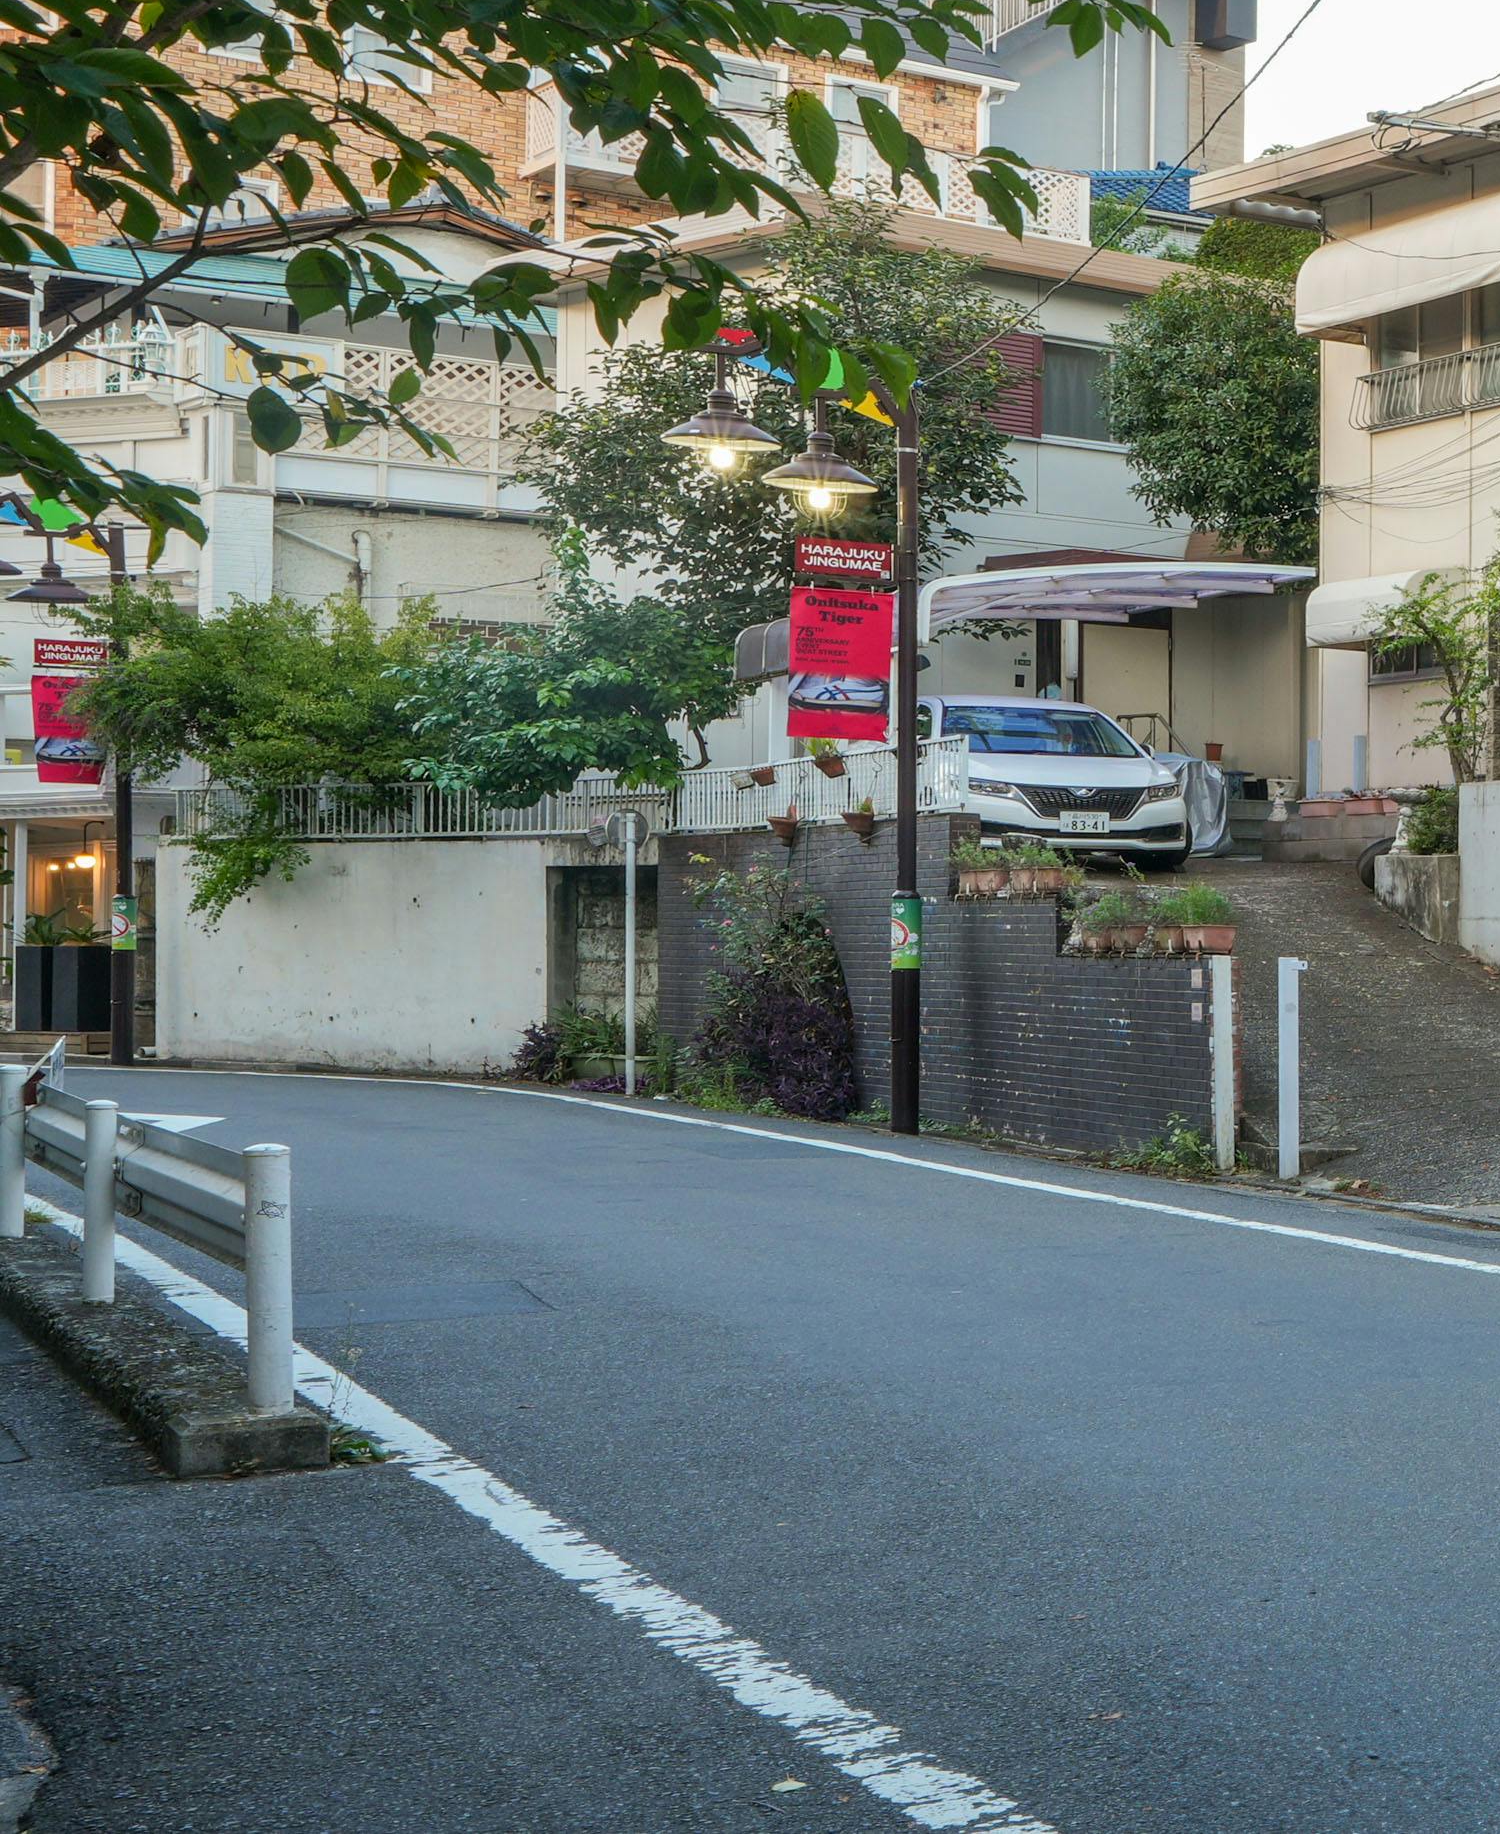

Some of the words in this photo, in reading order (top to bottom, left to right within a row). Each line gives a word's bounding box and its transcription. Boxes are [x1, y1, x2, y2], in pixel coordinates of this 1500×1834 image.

[801, 544, 886, 560] HARAJUKU
[804, 556, 882, 571] JINGUMAE
[805, 595, 880, 611] Onitsuka
[819, 610, 864, 625] Tiger
[38, 643, 103, 655] HARAJUKU
[1071, 820, 1105, 831] 83-41
